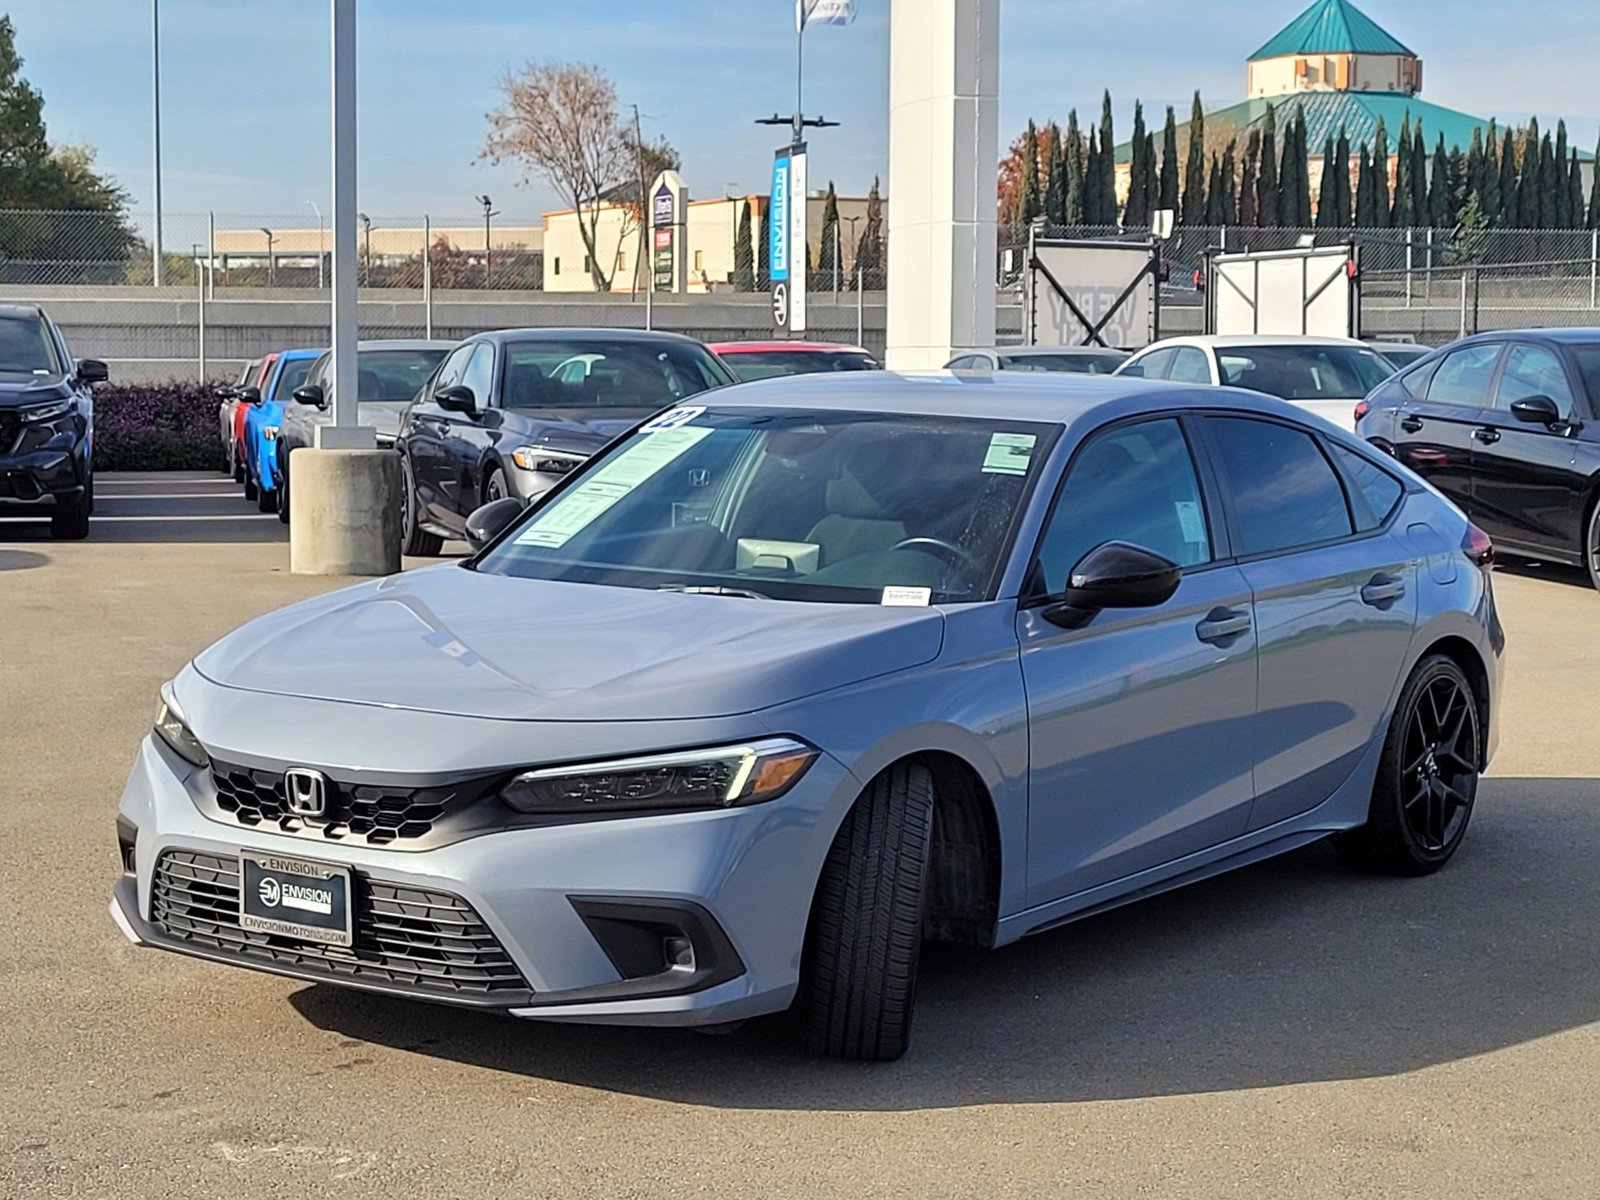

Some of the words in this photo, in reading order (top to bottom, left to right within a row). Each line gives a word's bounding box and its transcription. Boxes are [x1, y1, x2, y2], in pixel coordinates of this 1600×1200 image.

[773, 167, 786, 271] ENVISION
[647, 409, 697, 429] 22
[269, 858, 319, 876] ENVISION
[281, 883, 332, 905] ENVISION
[244, 917, 347, 944] ENVISIONMOTORS.COM
